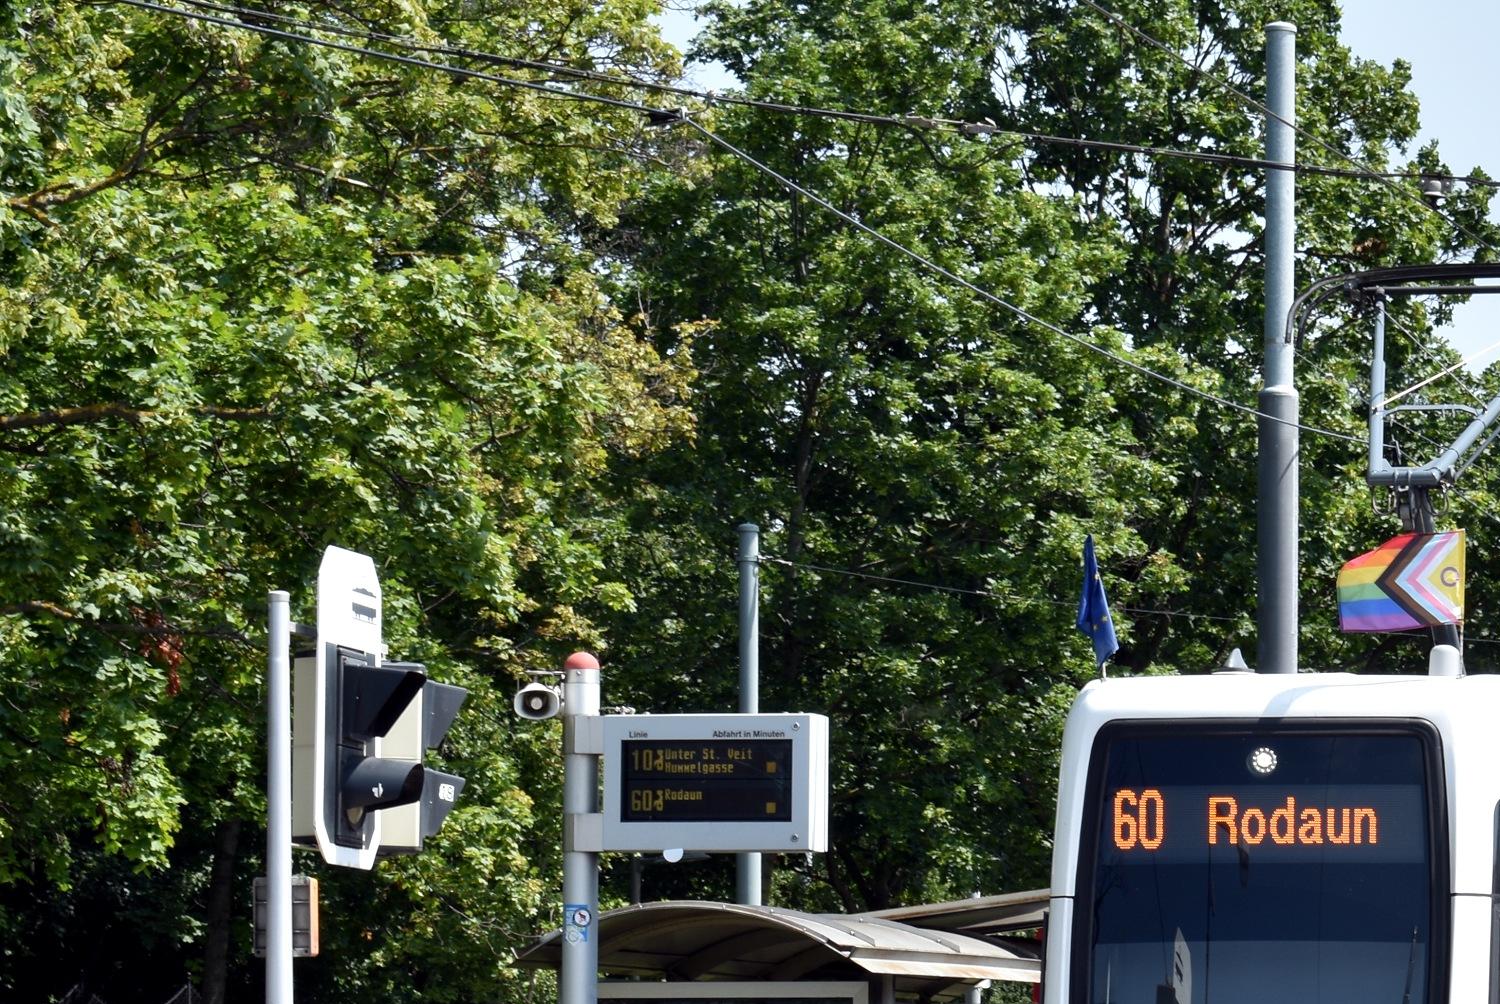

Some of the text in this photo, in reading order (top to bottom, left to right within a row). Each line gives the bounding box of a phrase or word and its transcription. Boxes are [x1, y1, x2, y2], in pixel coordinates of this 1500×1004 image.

[712, 730, 785, 738] Abfahrt in Minuten
[632, 749, 651, 771] 10
[665, 748, 752, 760] Unter St. Veit
[631, 788, 702, 811] 60 Rodaun
[1113, 789, 1378, 850] 60 Rodaun
